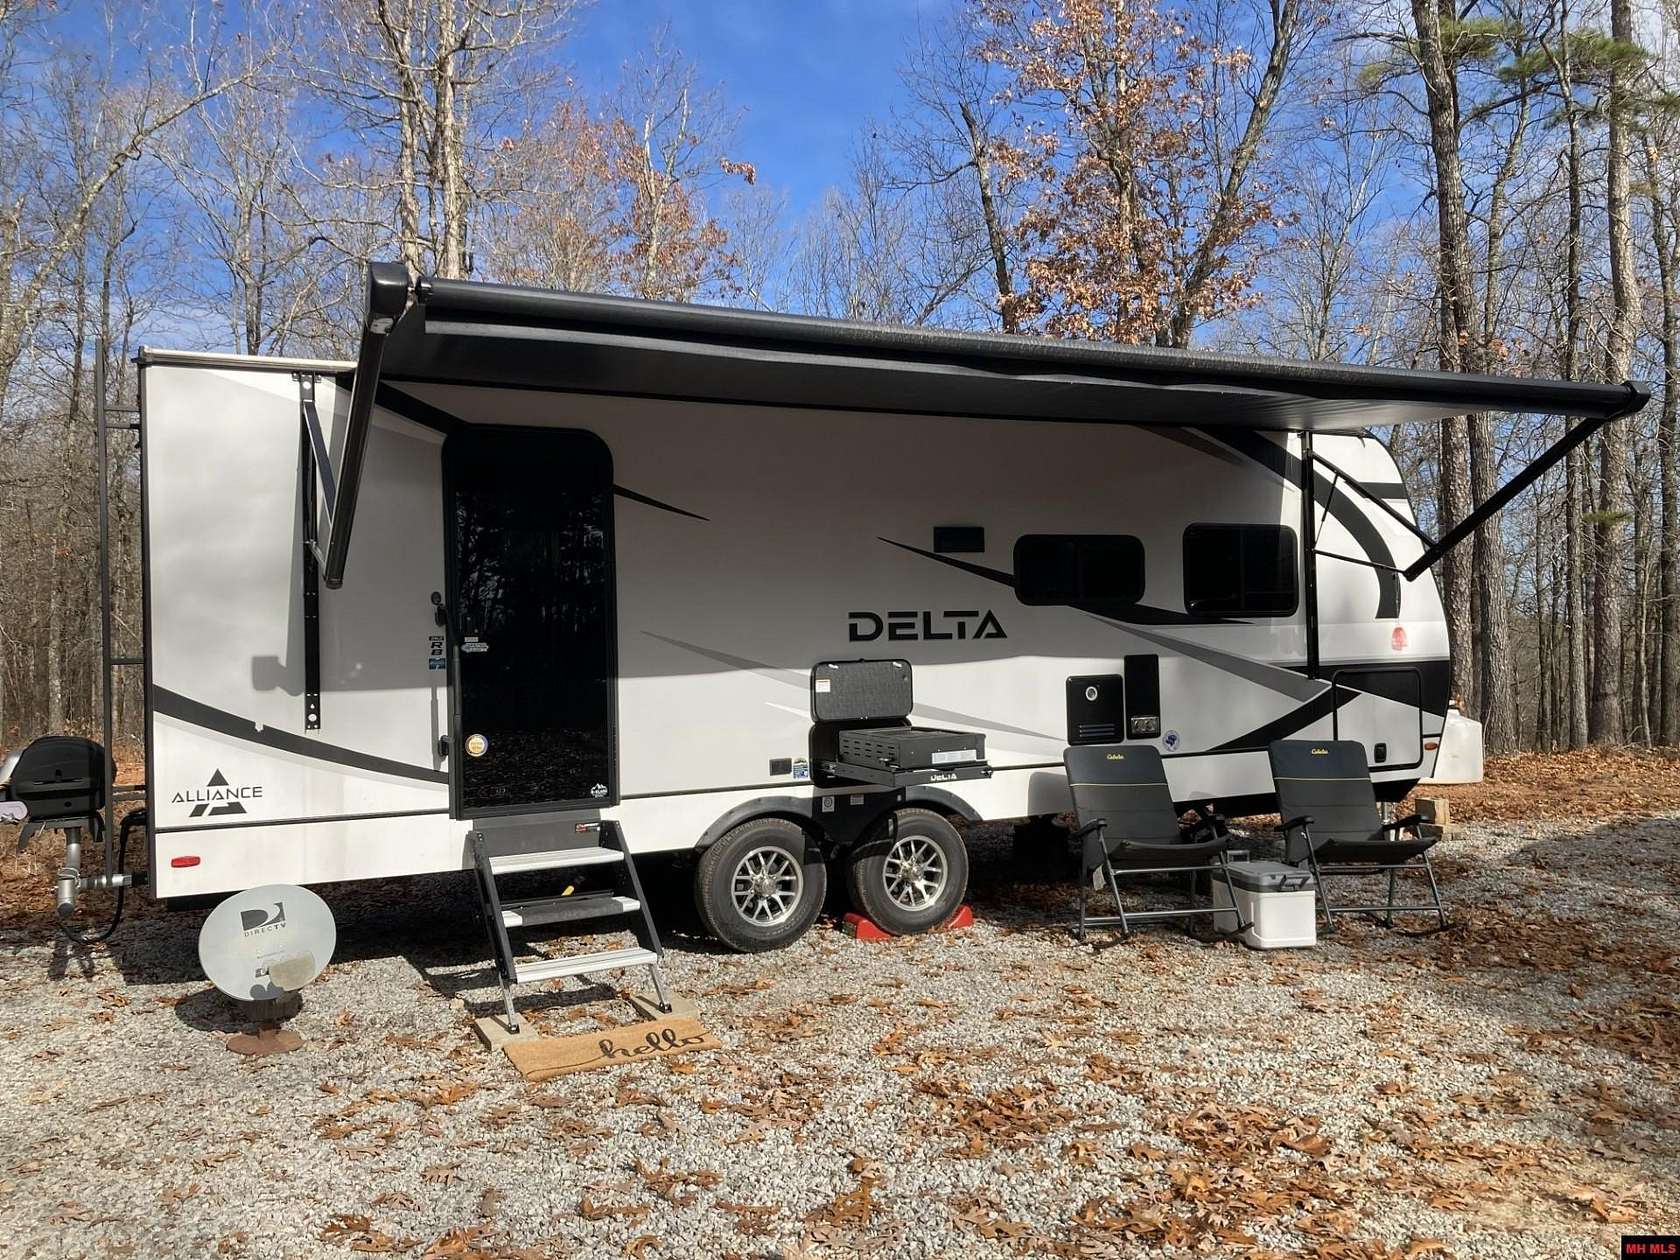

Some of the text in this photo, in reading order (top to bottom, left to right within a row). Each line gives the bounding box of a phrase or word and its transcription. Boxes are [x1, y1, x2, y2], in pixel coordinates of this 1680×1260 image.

[848, 609, 1008, 642] DELTA
[172, 786, 263, 803] ALLIANCE
[244, 922, 287, 938] DIRECTV
[598, 1028, 711, 1059] hello
